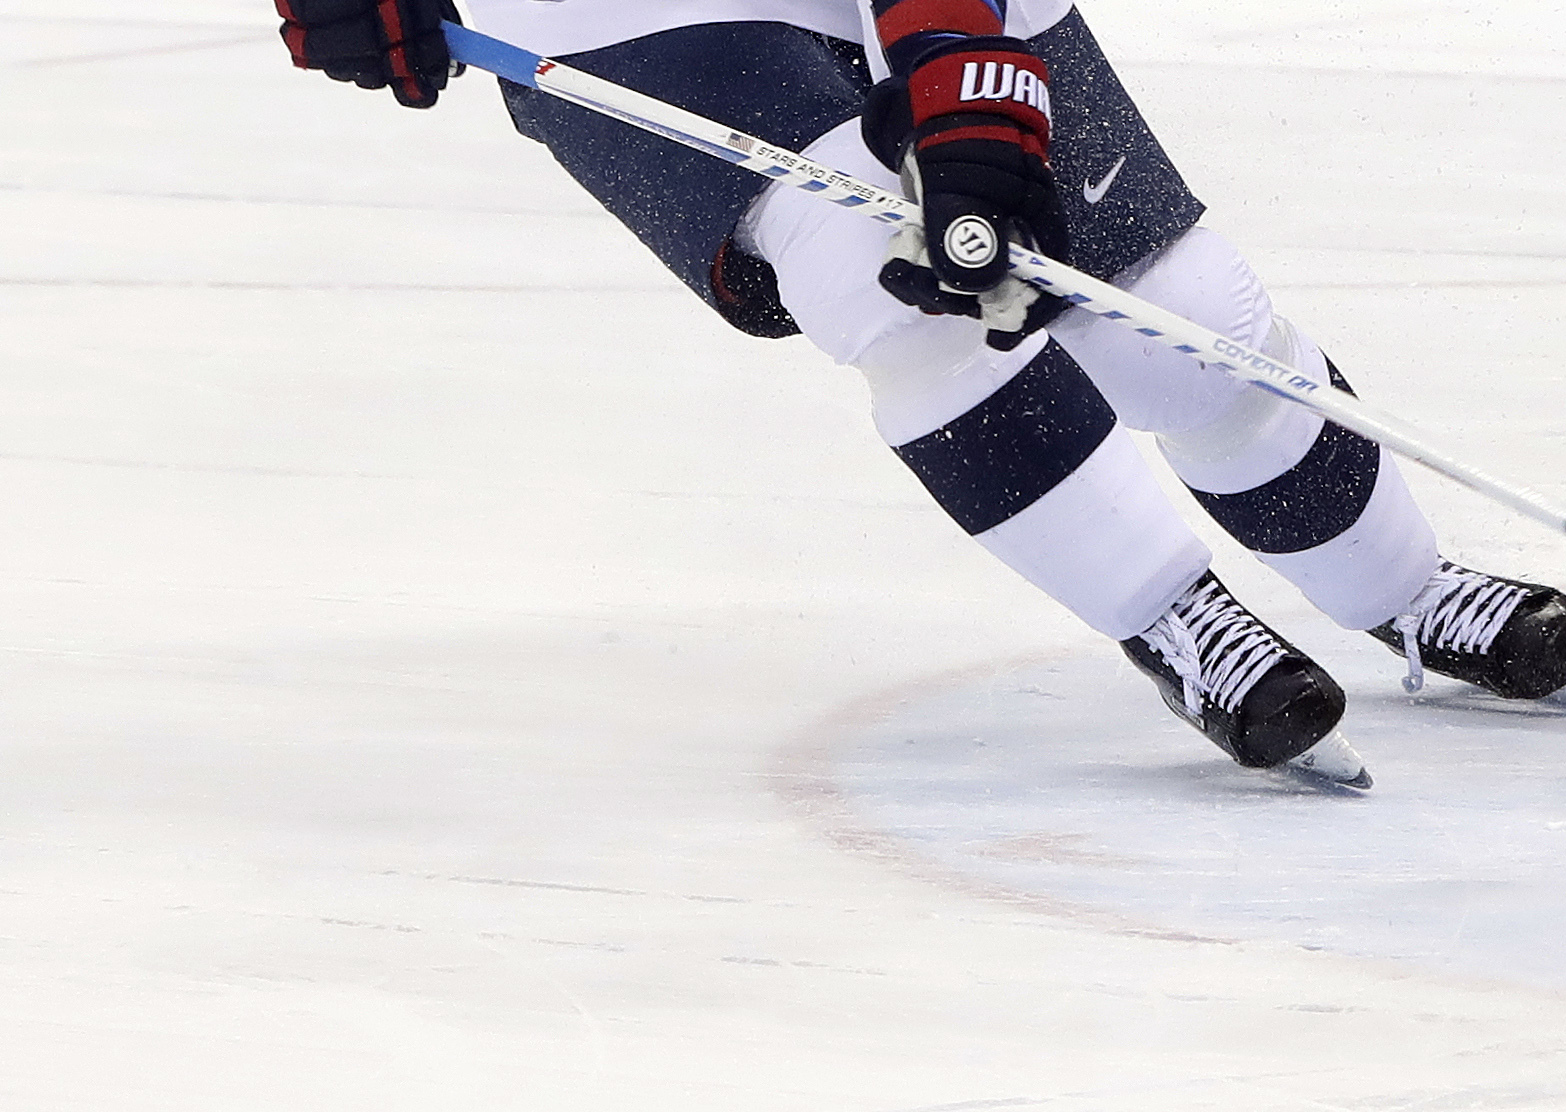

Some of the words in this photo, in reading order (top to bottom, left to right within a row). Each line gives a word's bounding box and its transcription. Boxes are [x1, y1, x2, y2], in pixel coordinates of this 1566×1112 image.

[756, 146, 796, 167] STARS
[796, 163, 826, 179] AND
[827, 174, 876, 199] STRIPES
